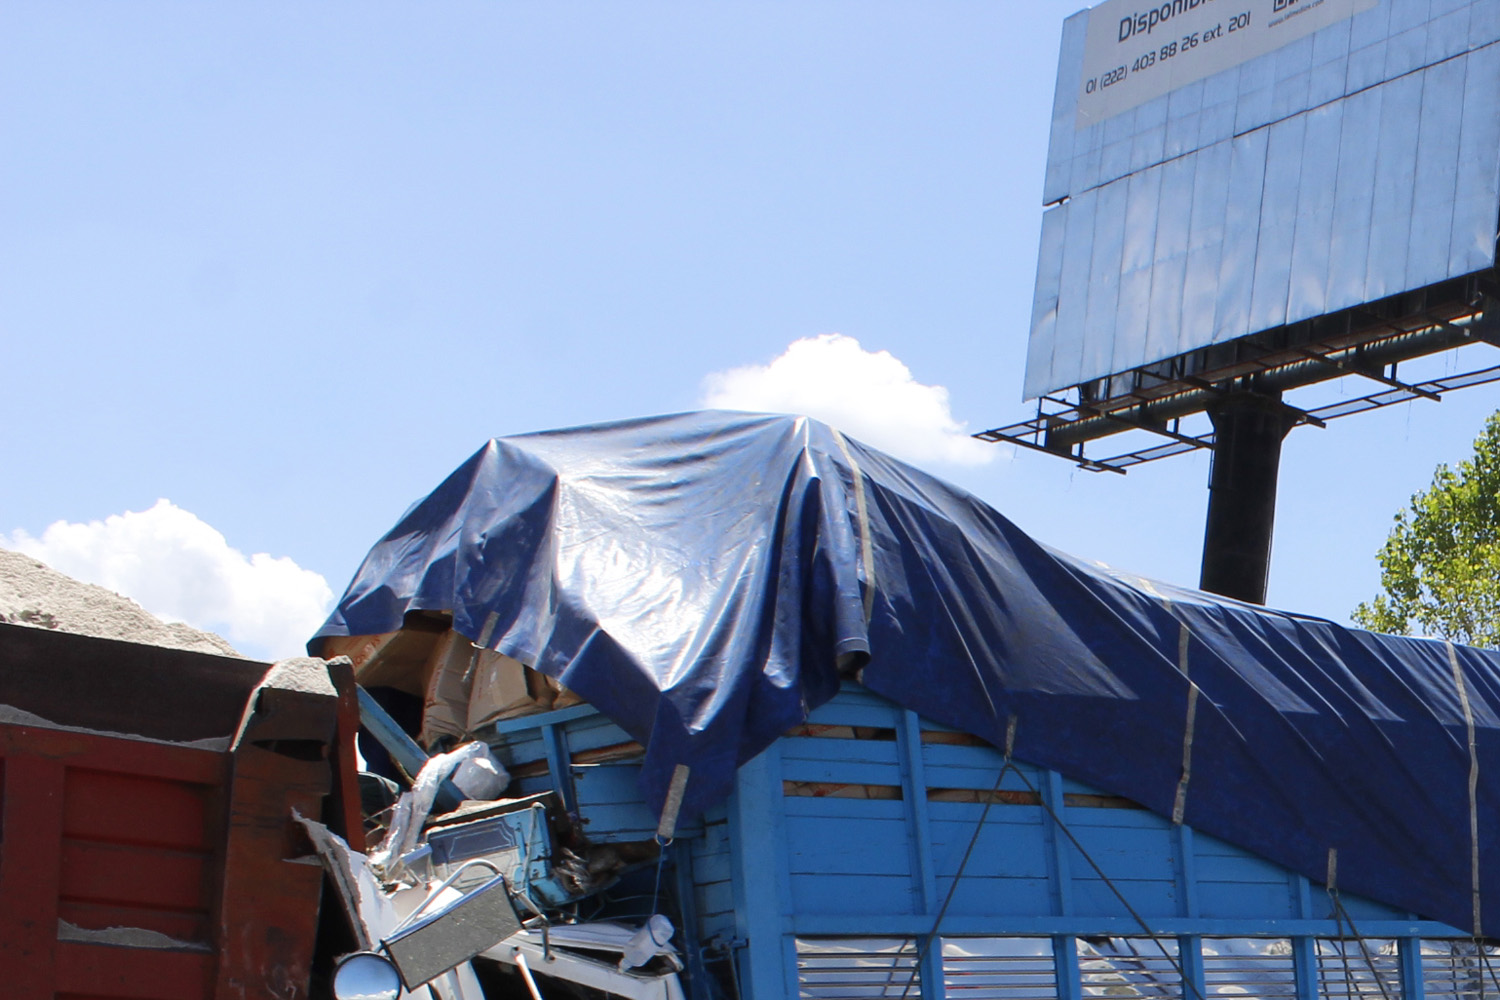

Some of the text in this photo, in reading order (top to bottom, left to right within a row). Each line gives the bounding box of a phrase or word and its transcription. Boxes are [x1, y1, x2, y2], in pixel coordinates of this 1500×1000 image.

[1119, 0, 1212, 42] Disponib
[1086, 11, 1251, 94] 01 (222) 403 88 26 ext. 201
